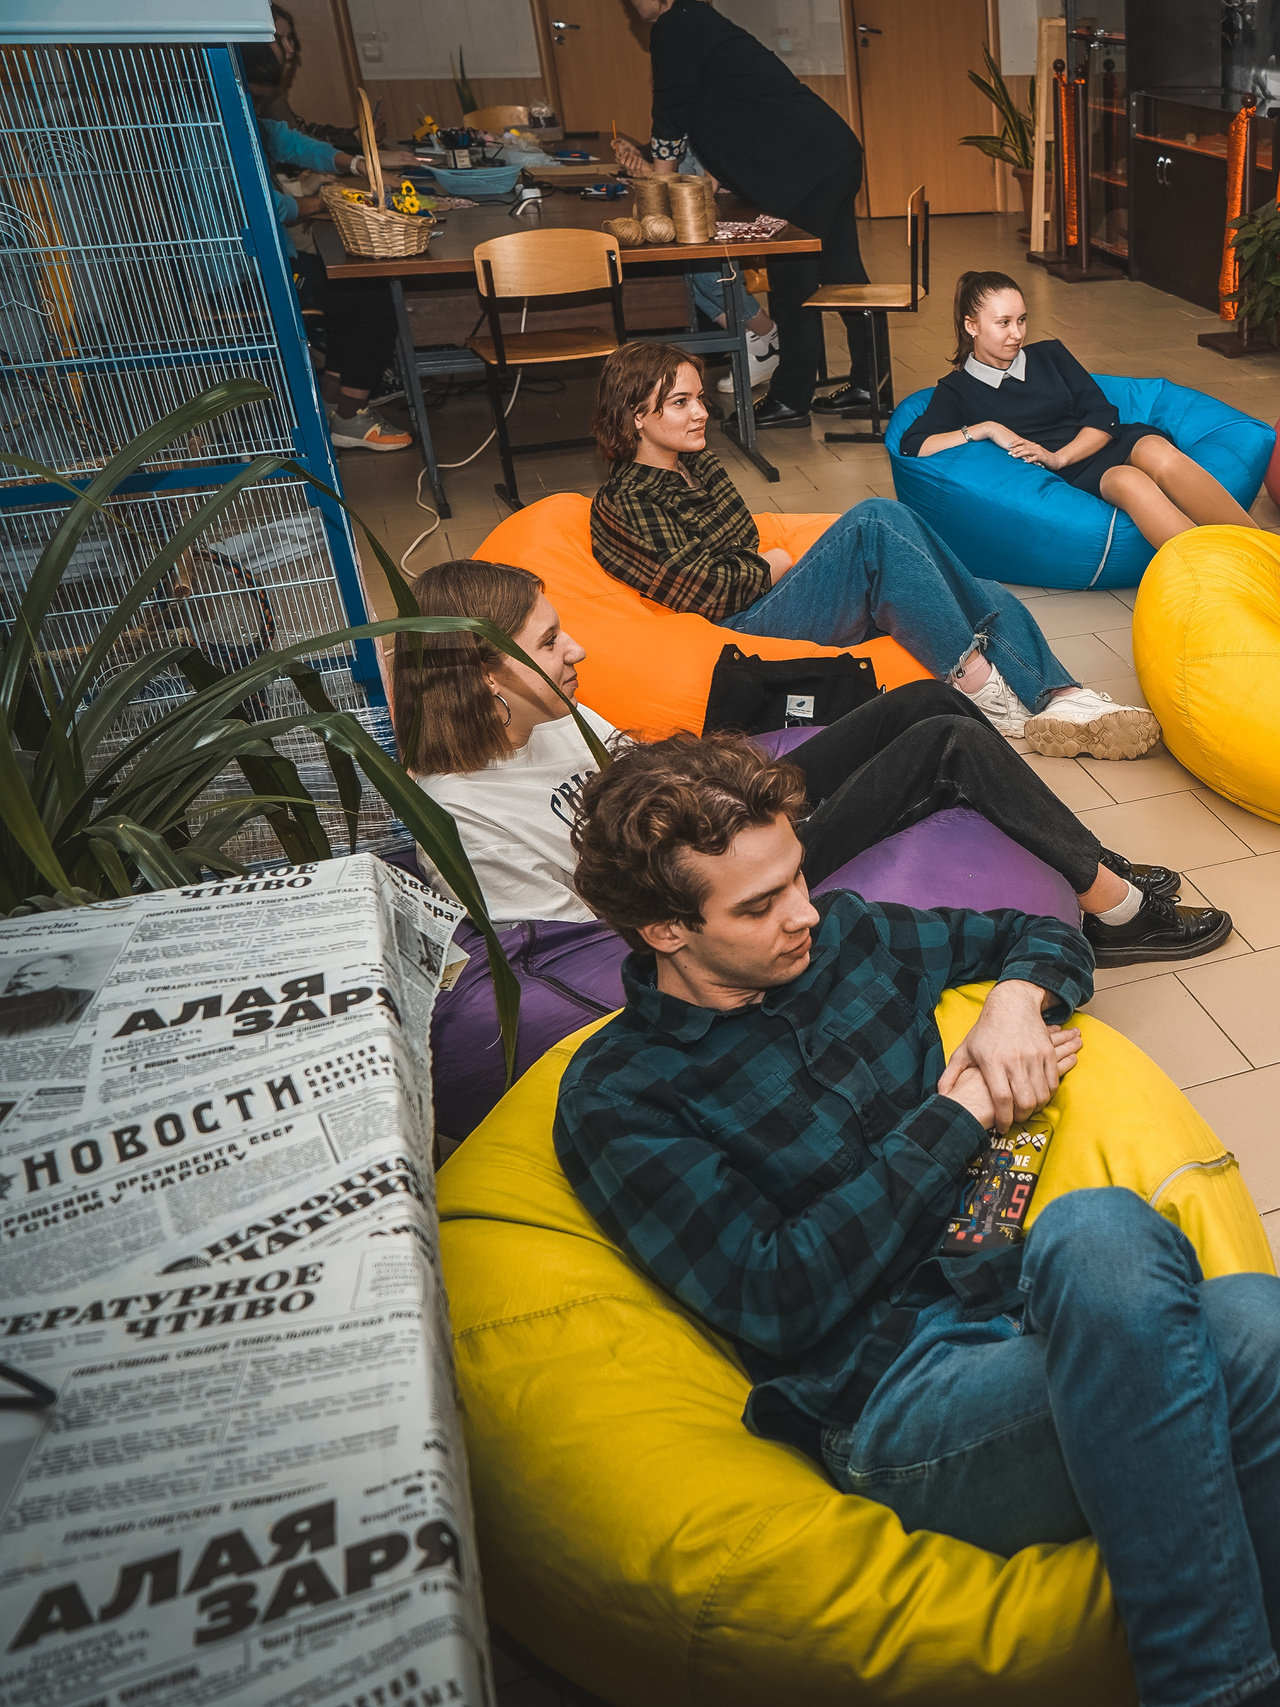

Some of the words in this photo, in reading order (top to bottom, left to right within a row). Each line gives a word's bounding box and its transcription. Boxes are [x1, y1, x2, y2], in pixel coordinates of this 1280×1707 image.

[179, 875, 313, 900] ЧТИВО
[112, 972, 325, 1039] АЛАЯ
[303, 1045, 378, 1077] СОВЕТОВ
[22, 1073, 303, 1193] НОВОСТИ
[116, 1143, 239, 1192] ПРЕЗИДЕНТА
[250, 1124, 295, 1146] СССР
[141, 1150, 248, 1194] НАРОДУ
[125, 1289, 316, 1341] ЧТИВО
[8, 1498, 338, 1655] АЛАЯ
[193, 1517, 464, 1648] ЗАРЯ
